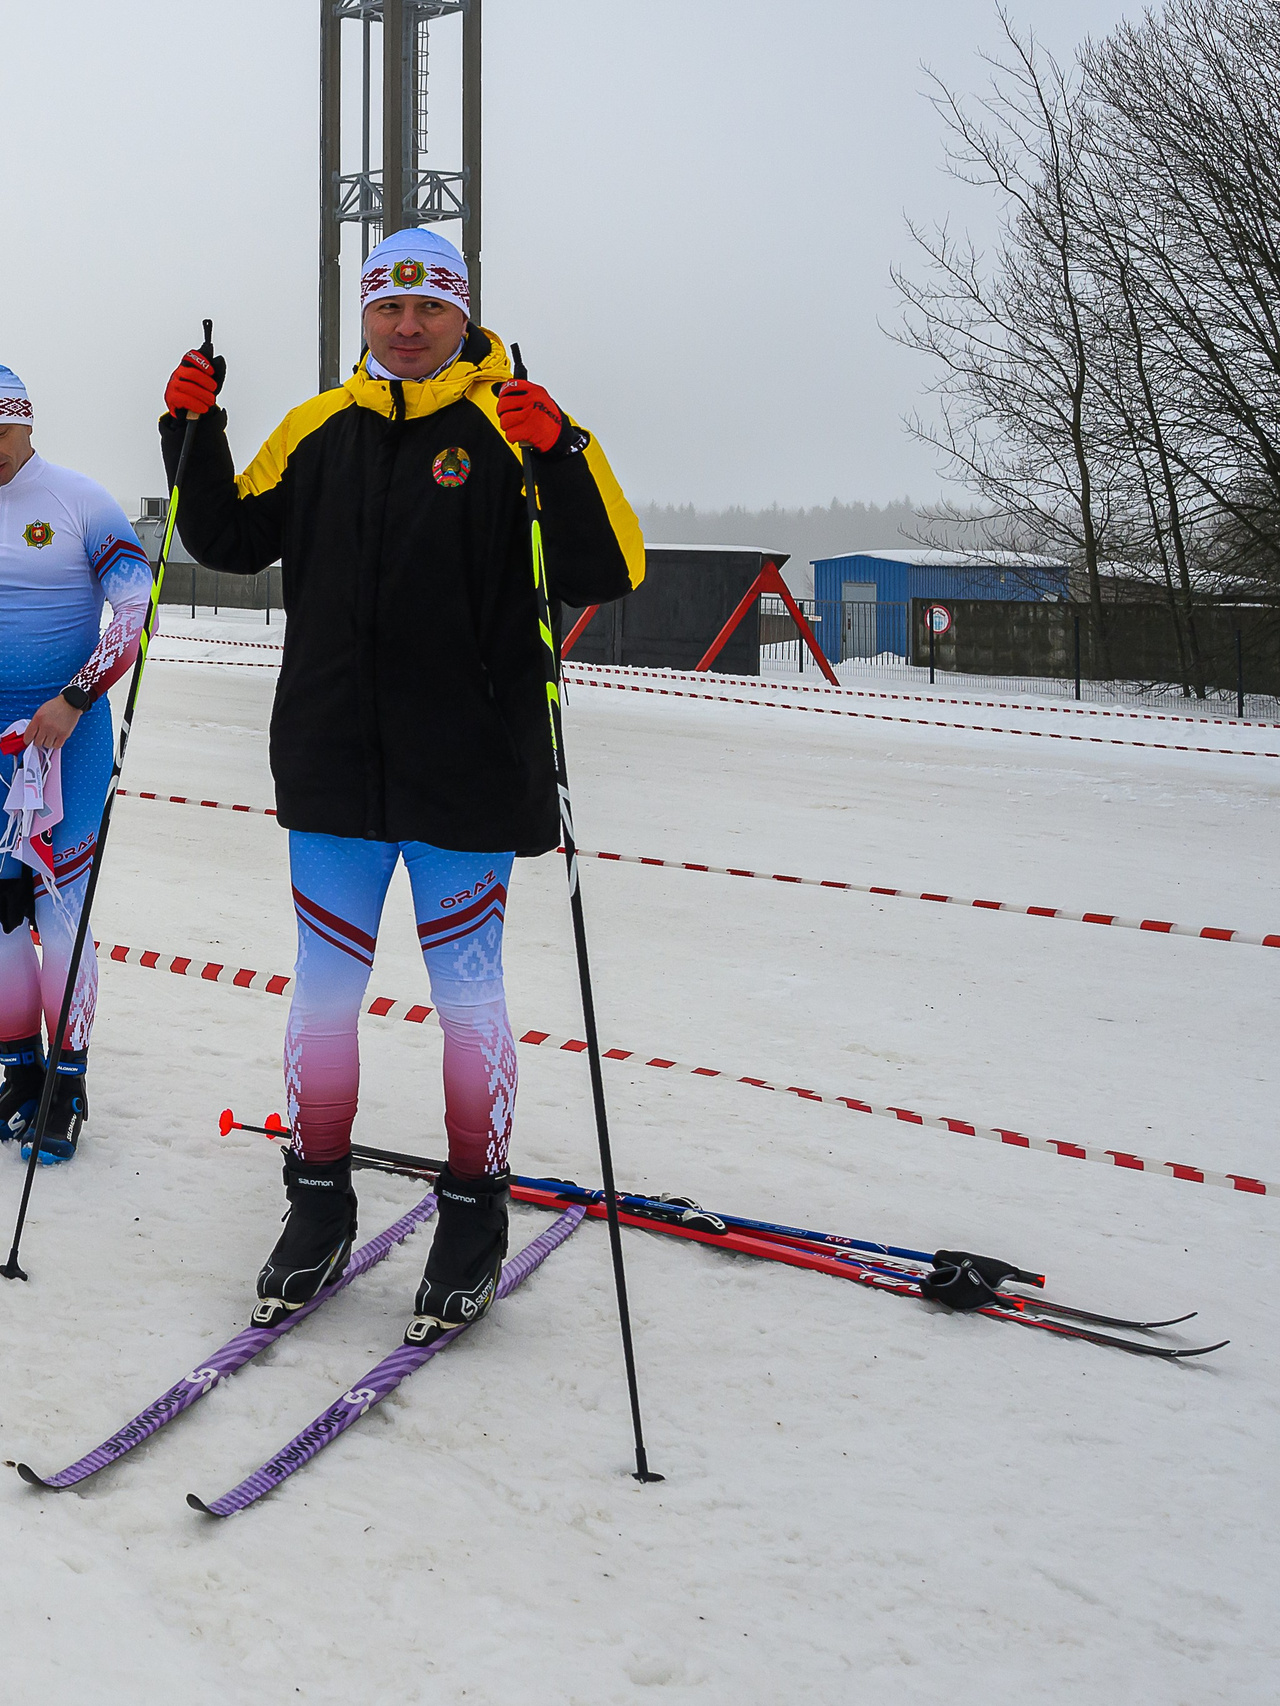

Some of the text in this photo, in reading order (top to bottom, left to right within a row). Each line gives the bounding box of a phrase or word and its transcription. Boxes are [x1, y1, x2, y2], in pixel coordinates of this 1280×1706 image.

[92, 533, 116, 562] RAZ
[439, 869, 497, 909] ORAZ
[102, 1387, 190, 1454] SNOWWAVE
[264, 1407, 349, 1477] SNOWWAVE
